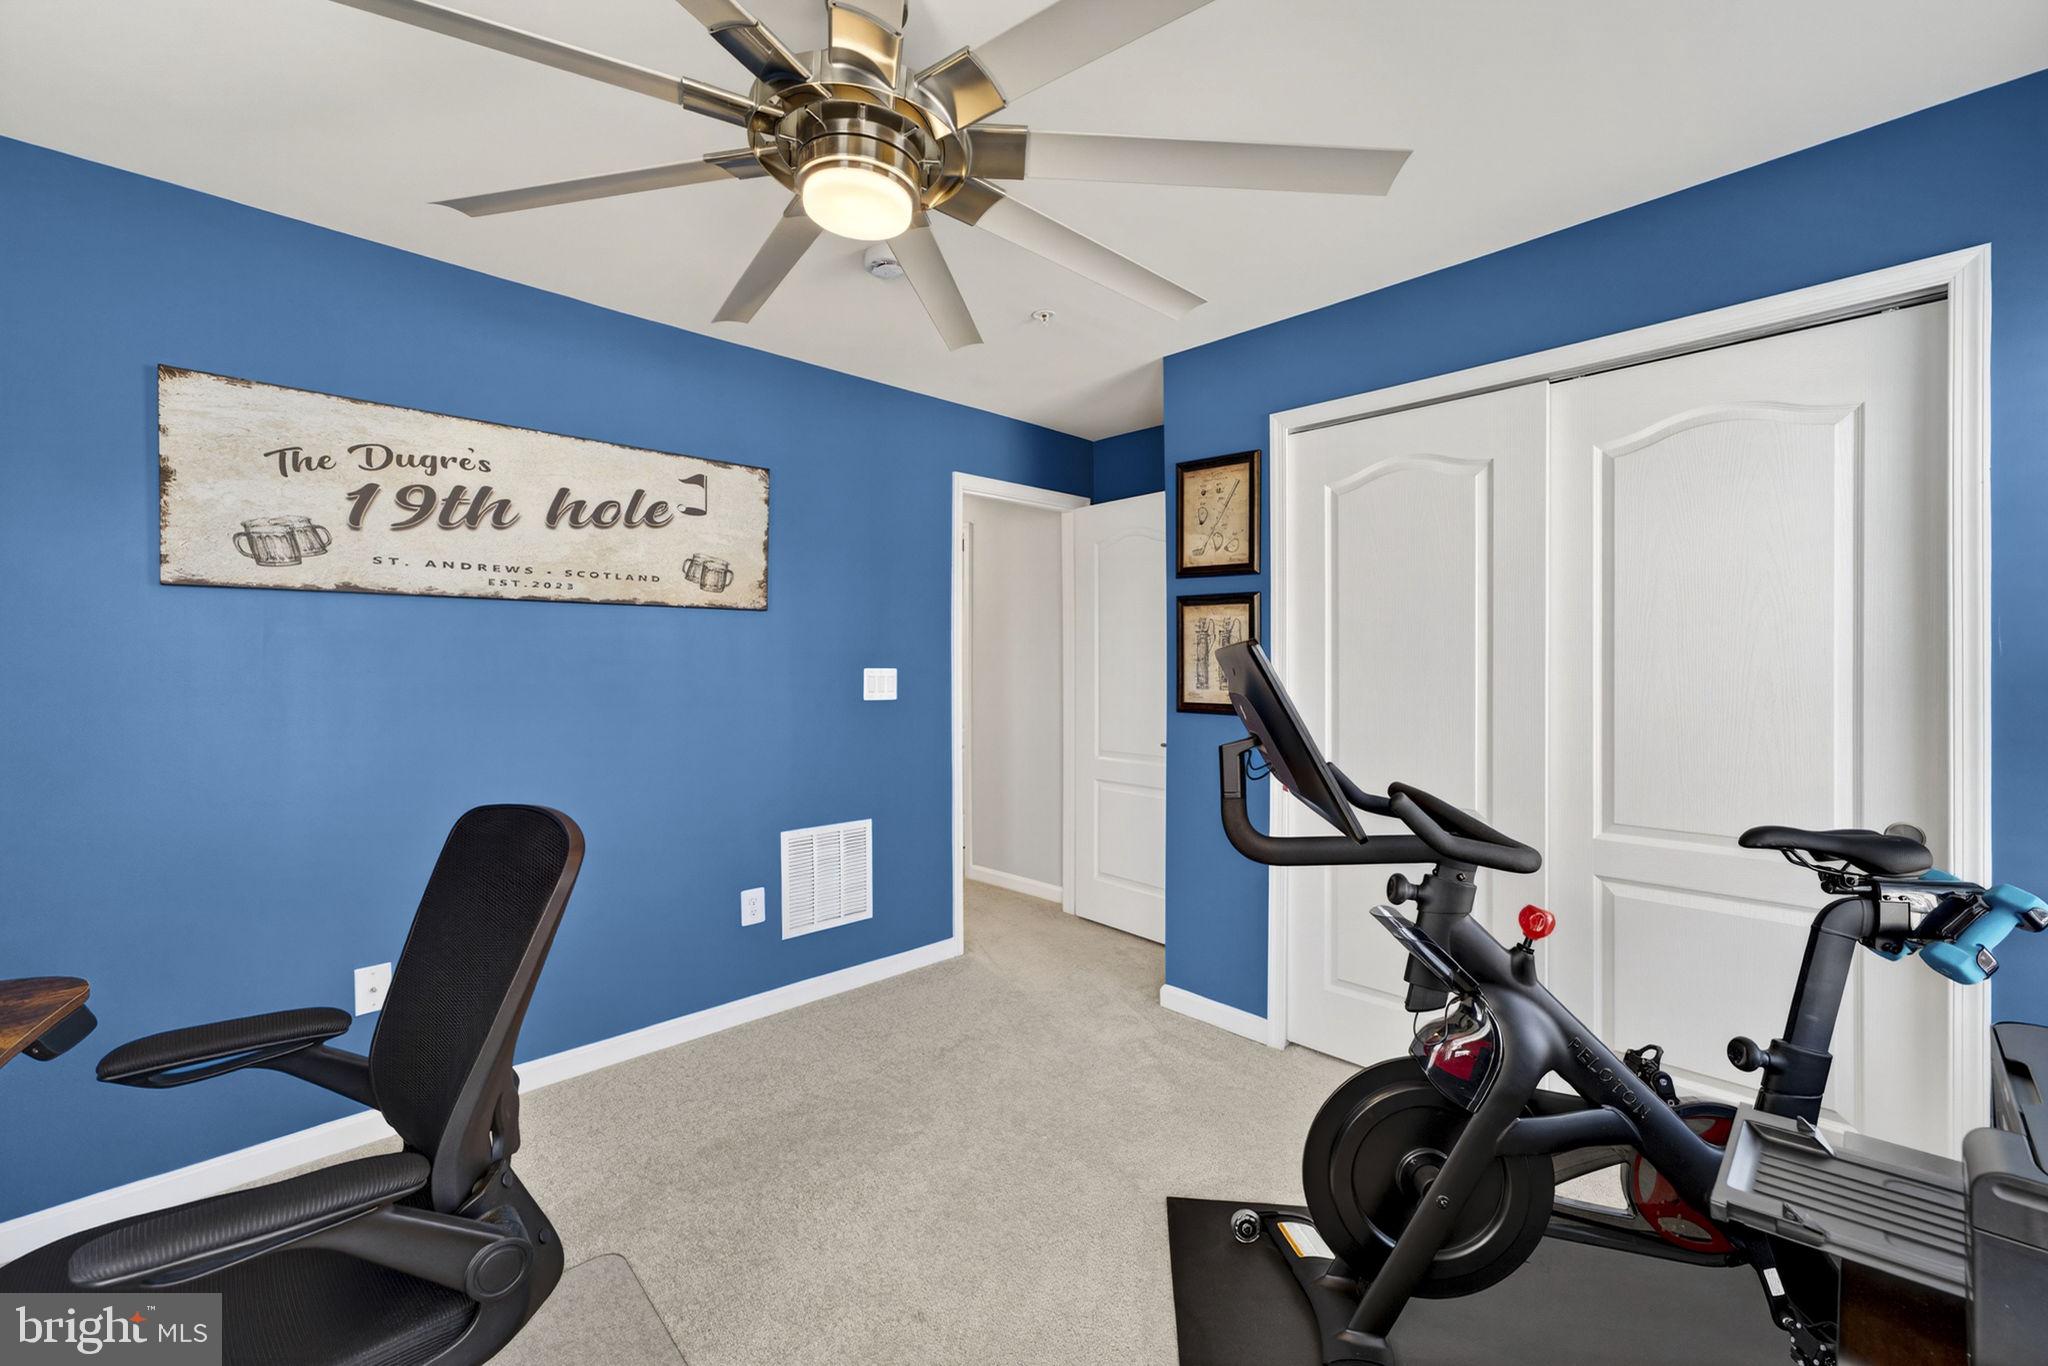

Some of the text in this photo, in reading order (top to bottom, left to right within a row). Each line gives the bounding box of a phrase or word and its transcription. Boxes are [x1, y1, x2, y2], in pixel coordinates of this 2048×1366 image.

[263, 446, 337, 478] The
[345, 482, 674, 532] 19th hole
[372, 556, 660, 583] ST. ANDREWS SCOTLAND
[488, 578, 574, 590] EST.2023
[1567, 1036, 1651, 1120] PELOTON
